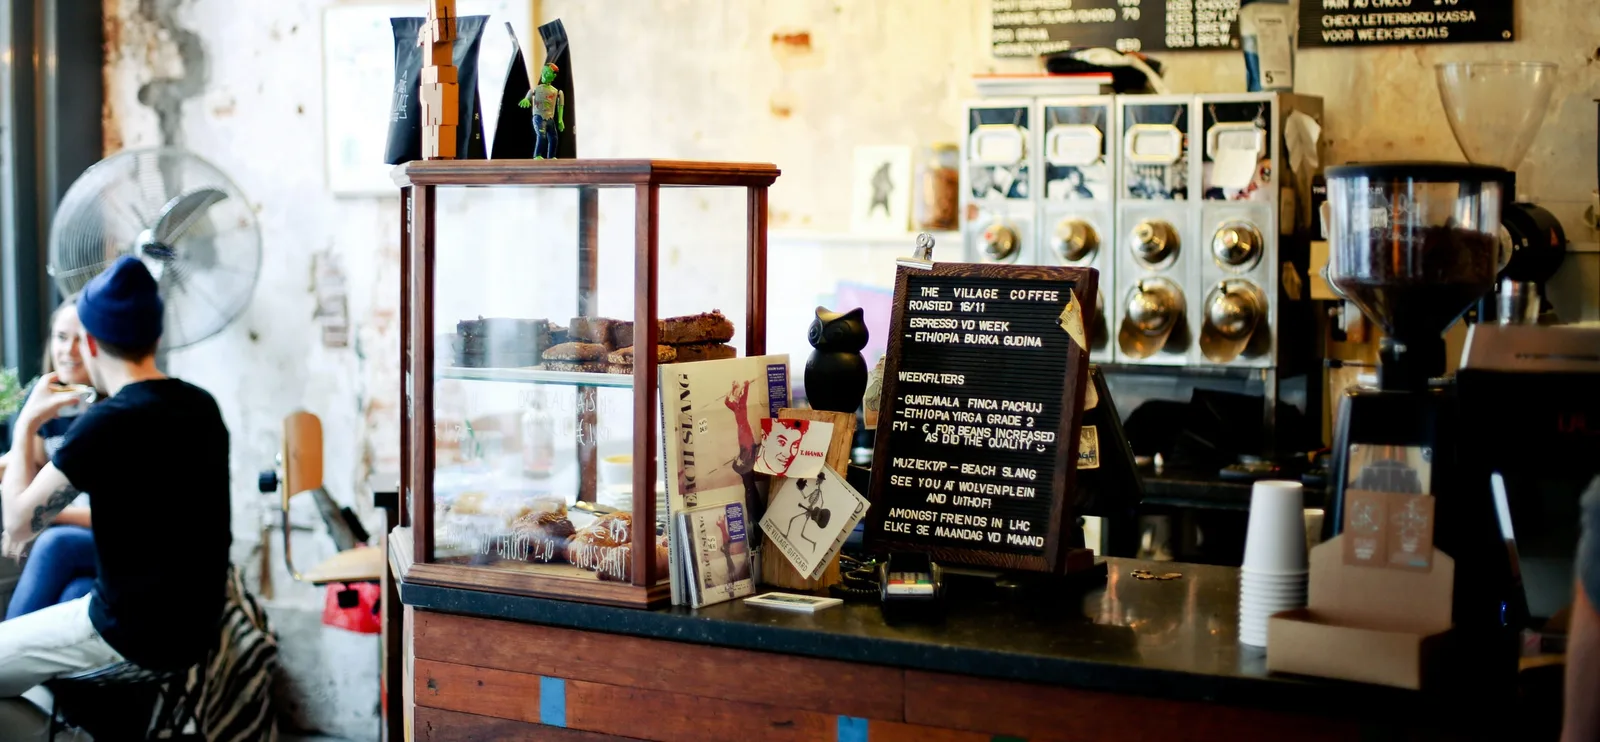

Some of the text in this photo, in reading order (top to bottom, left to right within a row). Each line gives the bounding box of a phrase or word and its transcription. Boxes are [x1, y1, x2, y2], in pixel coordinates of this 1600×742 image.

[1322, 14, 1361, 27] CHECK
[1436, 10, 1476, 23] KASSA
[1196, 33, 1230, 46] BREW
[1322, 26, 1449, 42] VOOR WEEKSPECIALS
[1265, 71, 1273, 84] 5
[921, 287, 939, 298] THE
[1010, 290, 1059, 301] COFFEE
[909, 301, 985, 312] ROASTED 16/11
[910, 318, 1009, 332] ESPRESSO VD WEEK
[915, 332, 959, 343] ETHIOPIA
[964, 334, 999, 345] BURKA
[1003, 336, 1042, 347] GUDINA
[898, 371, 965, 385] WEEKFILTERS
[905, 395, 960, 408] GUATEMALA
[968, 399, 998, 410] FINCA
[1002, 401, 1042, 413] PACHUJ
[952, 412, 982, 423] YIRGA
[987, 414, 1022, 426] GRADE
[1027, 417, 1034, 427] 2
[893, 421, 908, 432] FYI
[922, 423, 929, 434] €
[936, 425, 954, 436] FOR
[957, 426, 991, 438] BEANS
[995, 428, 1055, 442] INCREASED
[679, 373, 698, 508] EACH SLANG
[925, 432, 1032, 450] AS DID THE QUALITY
[961, 463, 996, 476] BEACH
[1002, 467, 1036, 480] SLANG
[890, 475, 1035, 498] SEE YOU AT WOLVENPLEIN
[926, 493, 946, 504] AND
[889, 508, 1030, 532] AMONGST FRIENDS IN LHC
[884, 521, 1044, 547] ELKE 3E MAANDAG VD MAAND
[763, 520, 809, 572] THE VILLAGE GIFTCARD
